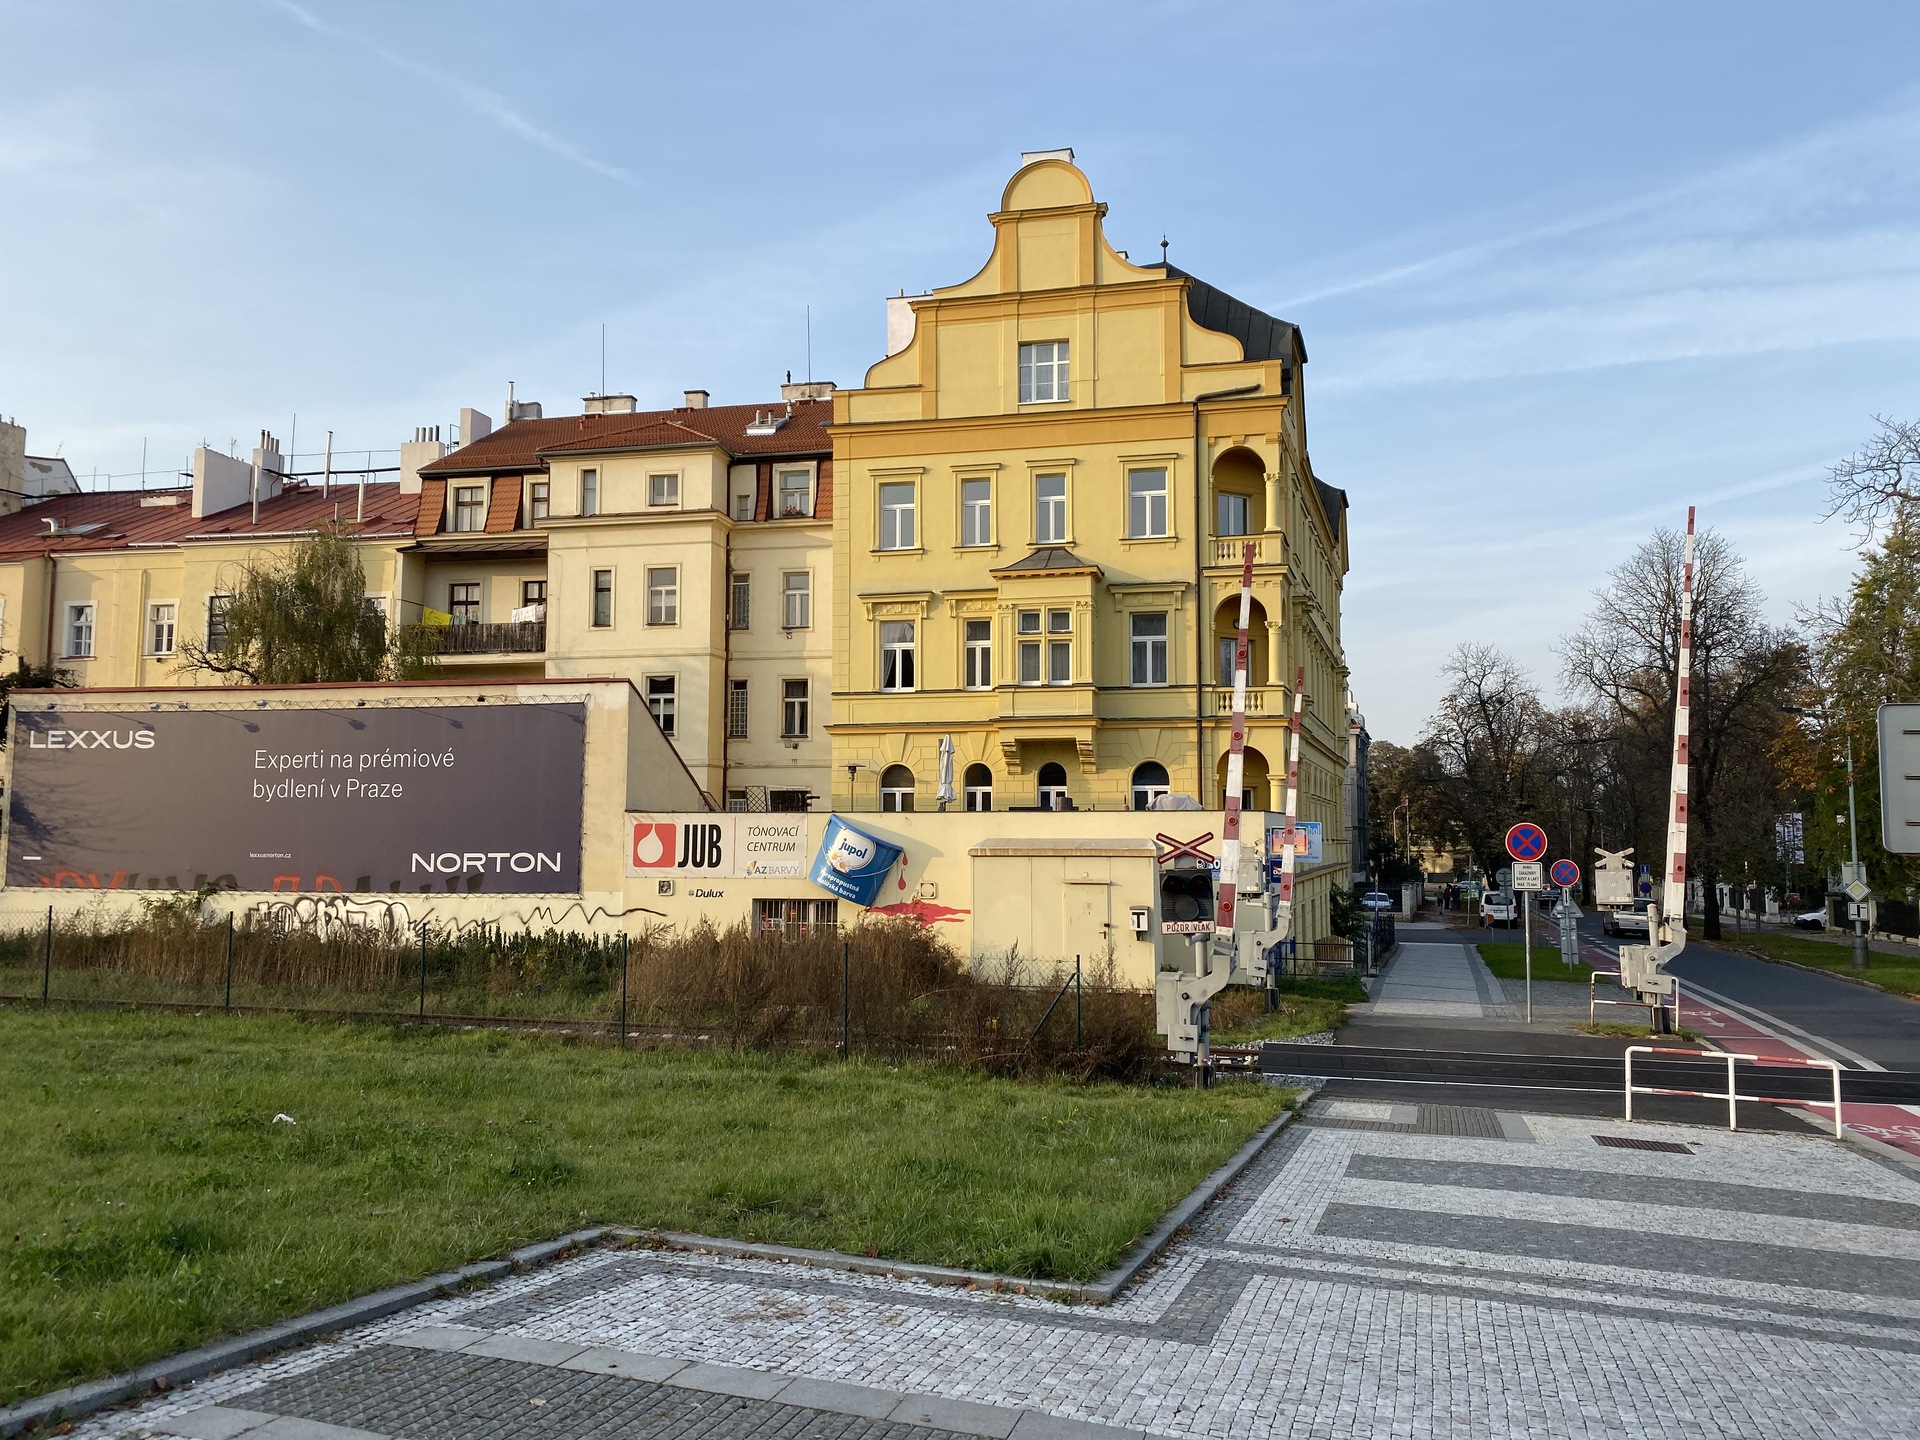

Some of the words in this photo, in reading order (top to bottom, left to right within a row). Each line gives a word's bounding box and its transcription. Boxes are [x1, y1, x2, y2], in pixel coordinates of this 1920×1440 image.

[29, 730, 155, 749] LEXXUS
[254, 749, 324, 773] Experti
[330, 753, 353, 769] na
[359, 747, 455, 772] prémiové
[253, 778, 326, 802] bydlení
[329, 783, 341, 798] v
[346, 778, 403, 798] Praze
[747, 825, 800, 837] TÓNOVACÍ
[677, 824, 722, 868] JUB
[746, 842, 796, 852] CENTRUM
[838, 838, 869, 859] jupol
[411, 852, 561, 873] NORTON
[695, 888, 725, 898] Dulux
[839, 887, 856, 900] barva
[1131, 912, 1145, 928] T
[1166, 923, 1190, 932] POZOR
[1193, 923, 1211, 932] VLAK
